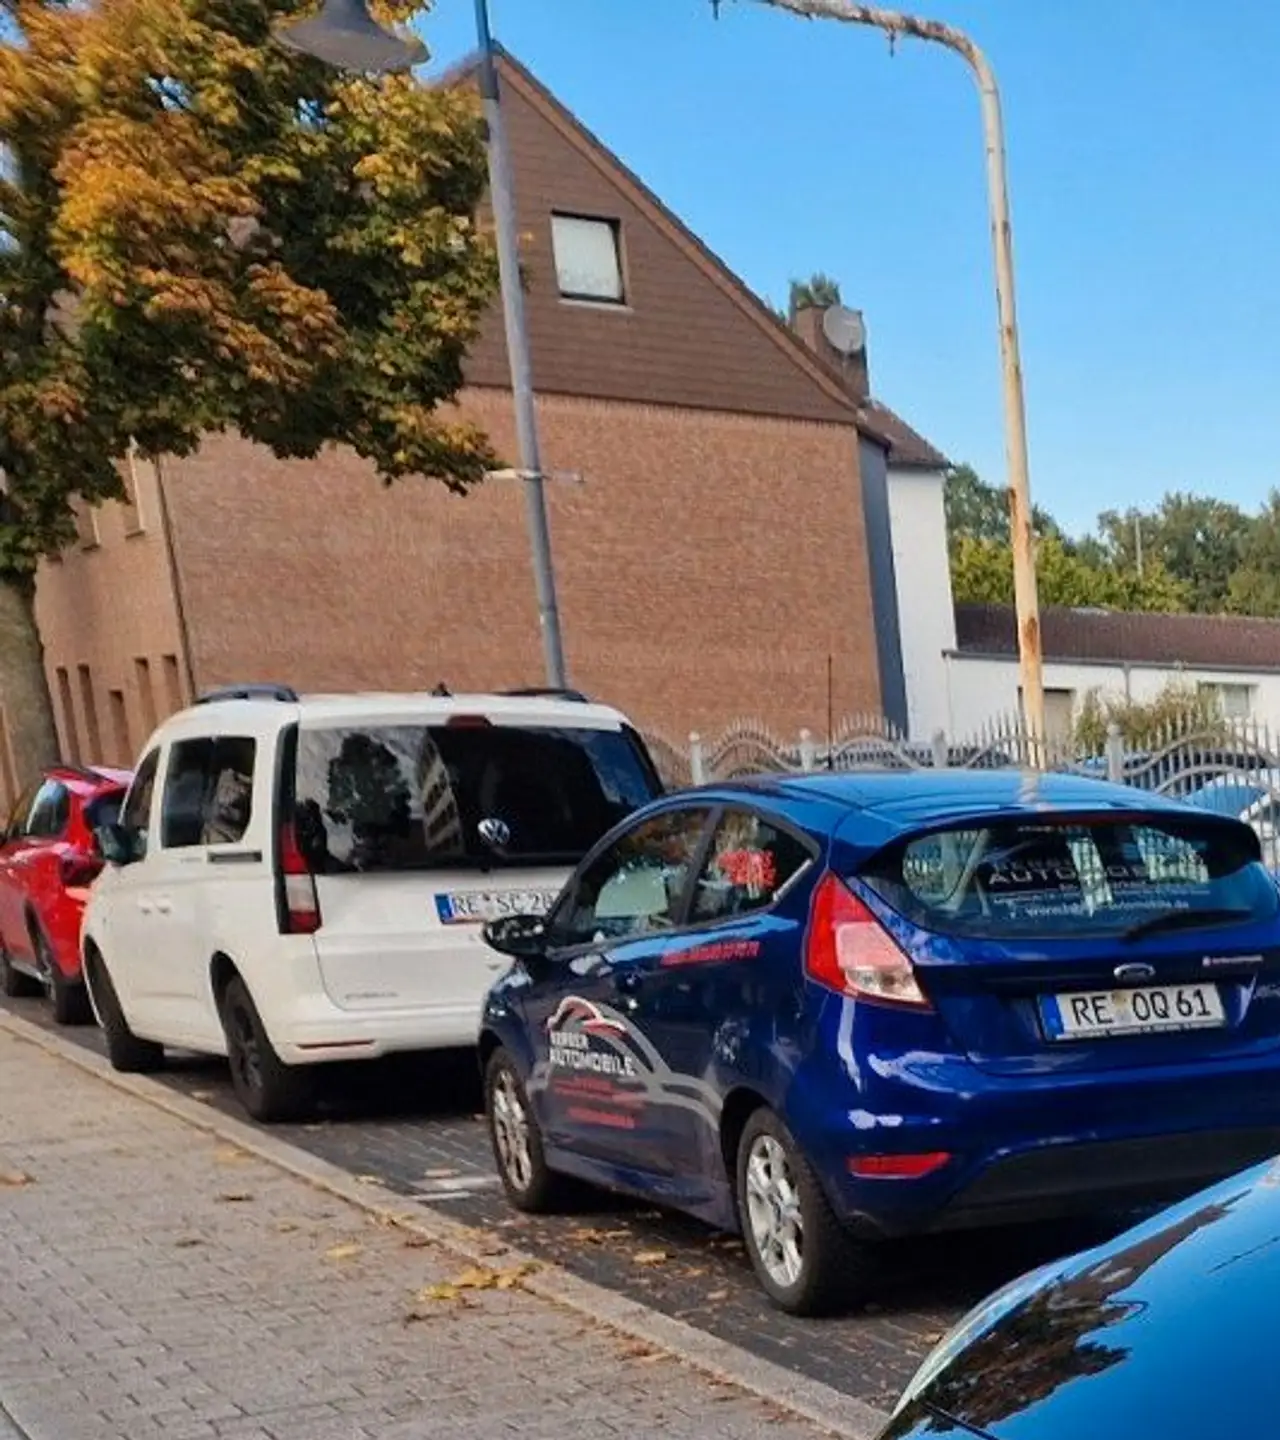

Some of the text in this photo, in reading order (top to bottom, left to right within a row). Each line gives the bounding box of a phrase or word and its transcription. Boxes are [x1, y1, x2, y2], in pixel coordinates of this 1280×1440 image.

[1071, 988, 1211, 1026] RE OQ 61
[550, 1047, 635, 1077] AUTOMOBILE
